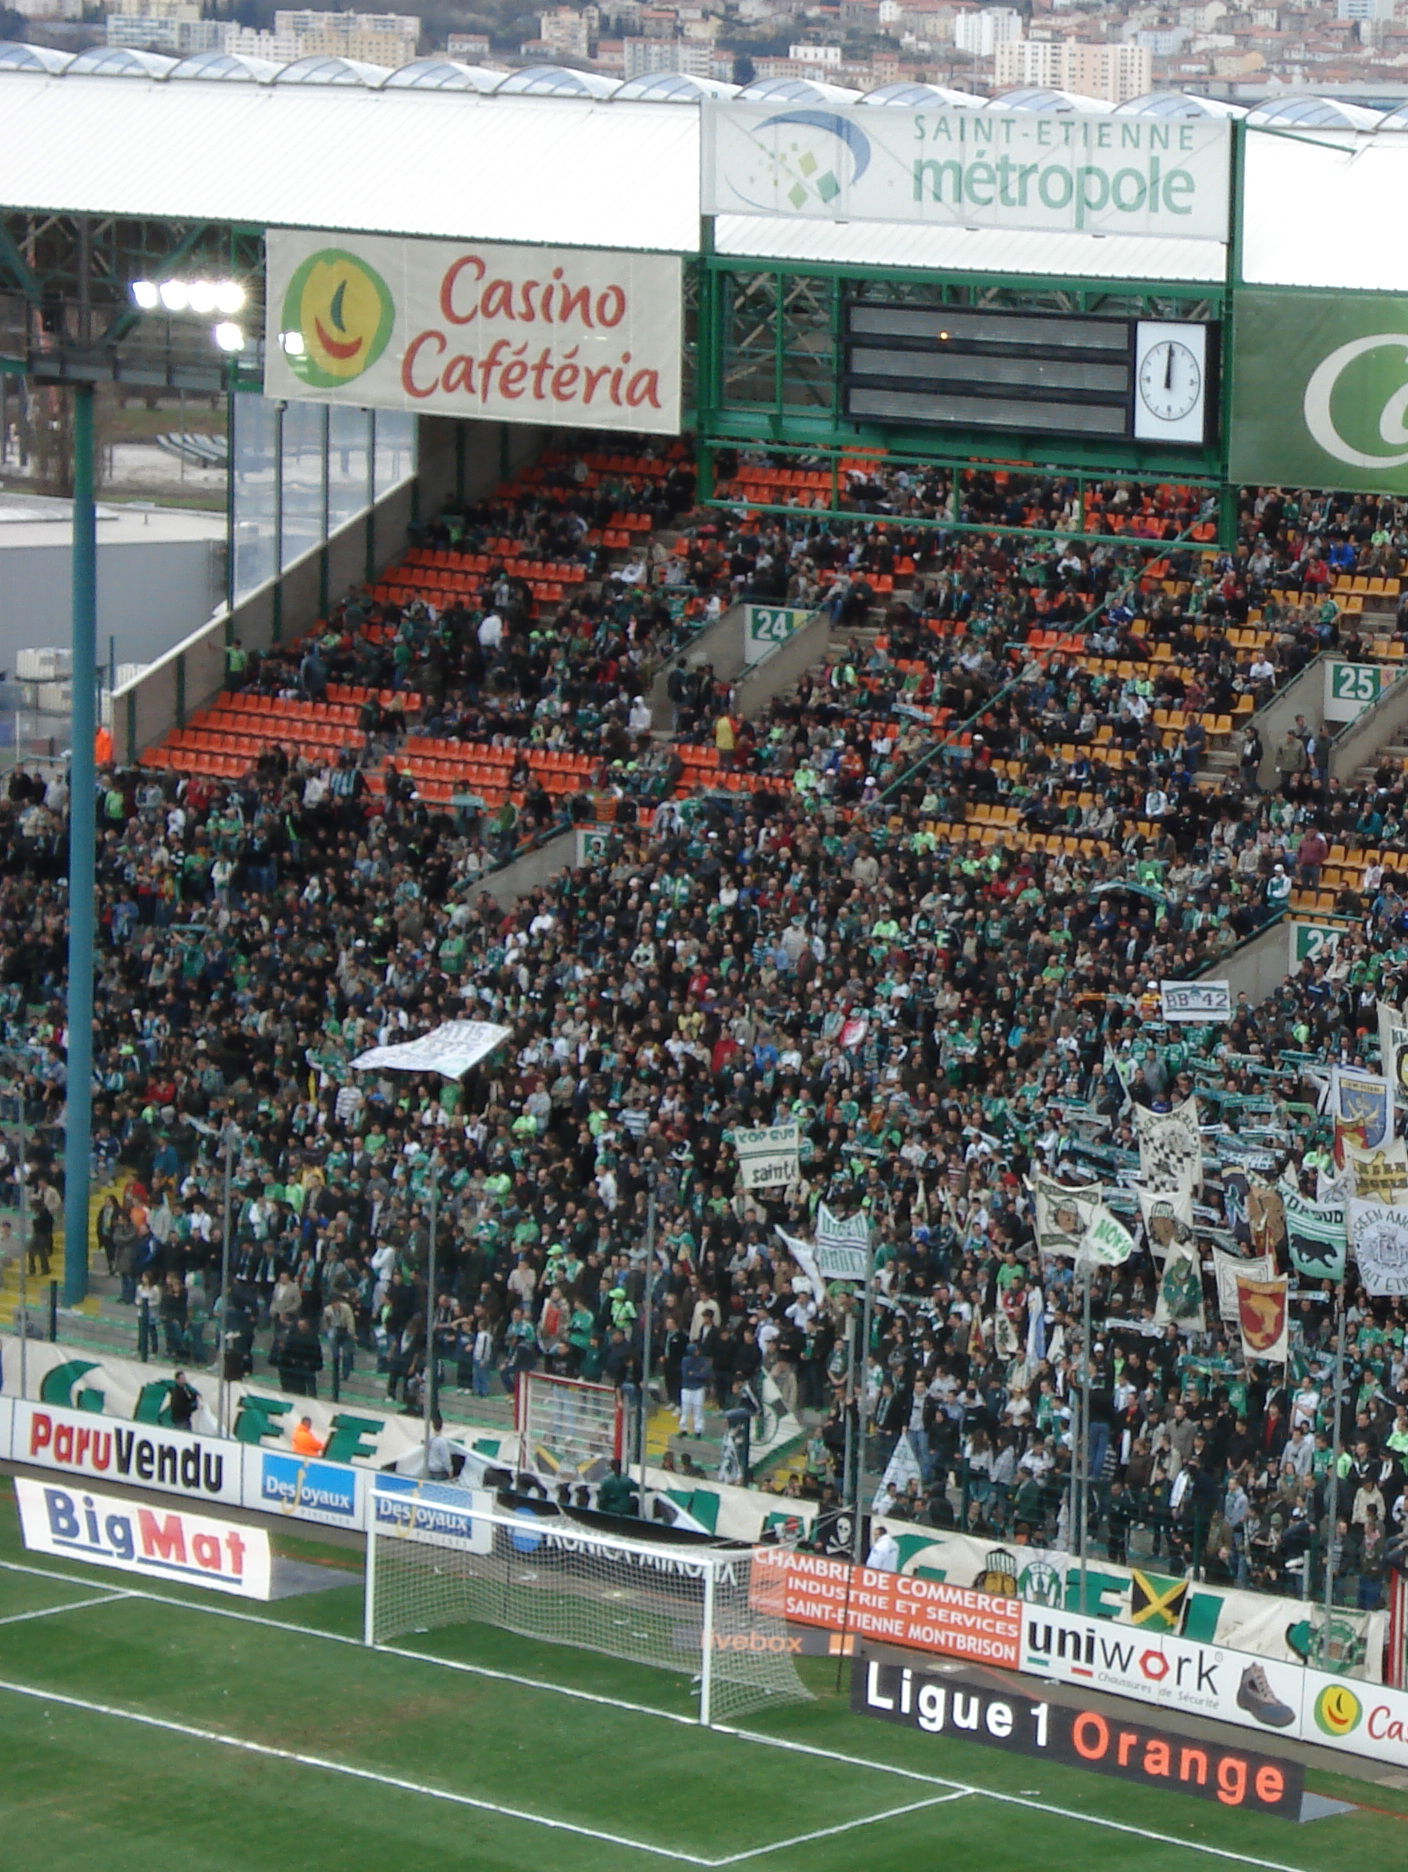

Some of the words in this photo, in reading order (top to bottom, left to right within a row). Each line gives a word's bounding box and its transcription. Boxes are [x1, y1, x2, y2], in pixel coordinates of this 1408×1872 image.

[914, 114, 1194, 150] SAINT-ETIENNE
[912, 149, 1195, 229] métropole
[441, 255, 626, 328] Casino
[402, 330, 661, 408] Cafétéria
[757, 612, 788, 640] 24
[1337, 667, 1374, 700] 25
[1166, 992, 1189, 1008] BB
[1202, 992, 1228, 1007] 42
[30, 1411, 223, 1493] ParuVendu
[45, 1487, 245, 1576] BigMat
[638, 1552, 737, 1587] MINOTA
[754, 1549, 855, 1584] CHAMBRE
[862, 1571, 889, 1591] DE
[897, 1577, 1019, 1618] COMMERCE
[786, 1596, 904, 1636] SAINT-ETIENNE
[908, 1622, 1016, 1662] MONTBRISON
[788, 1577, 888, 1611] INDUSTRIE
[895, 1600, 921, 1615] ET
[926, 1605, 1019, 1637] SERVICES
[866, 1661, 1014, 1738] Ligue
[1031, 1705, 1049, 1747] 1
[1072, 1710, 1286, 1806] Orange
